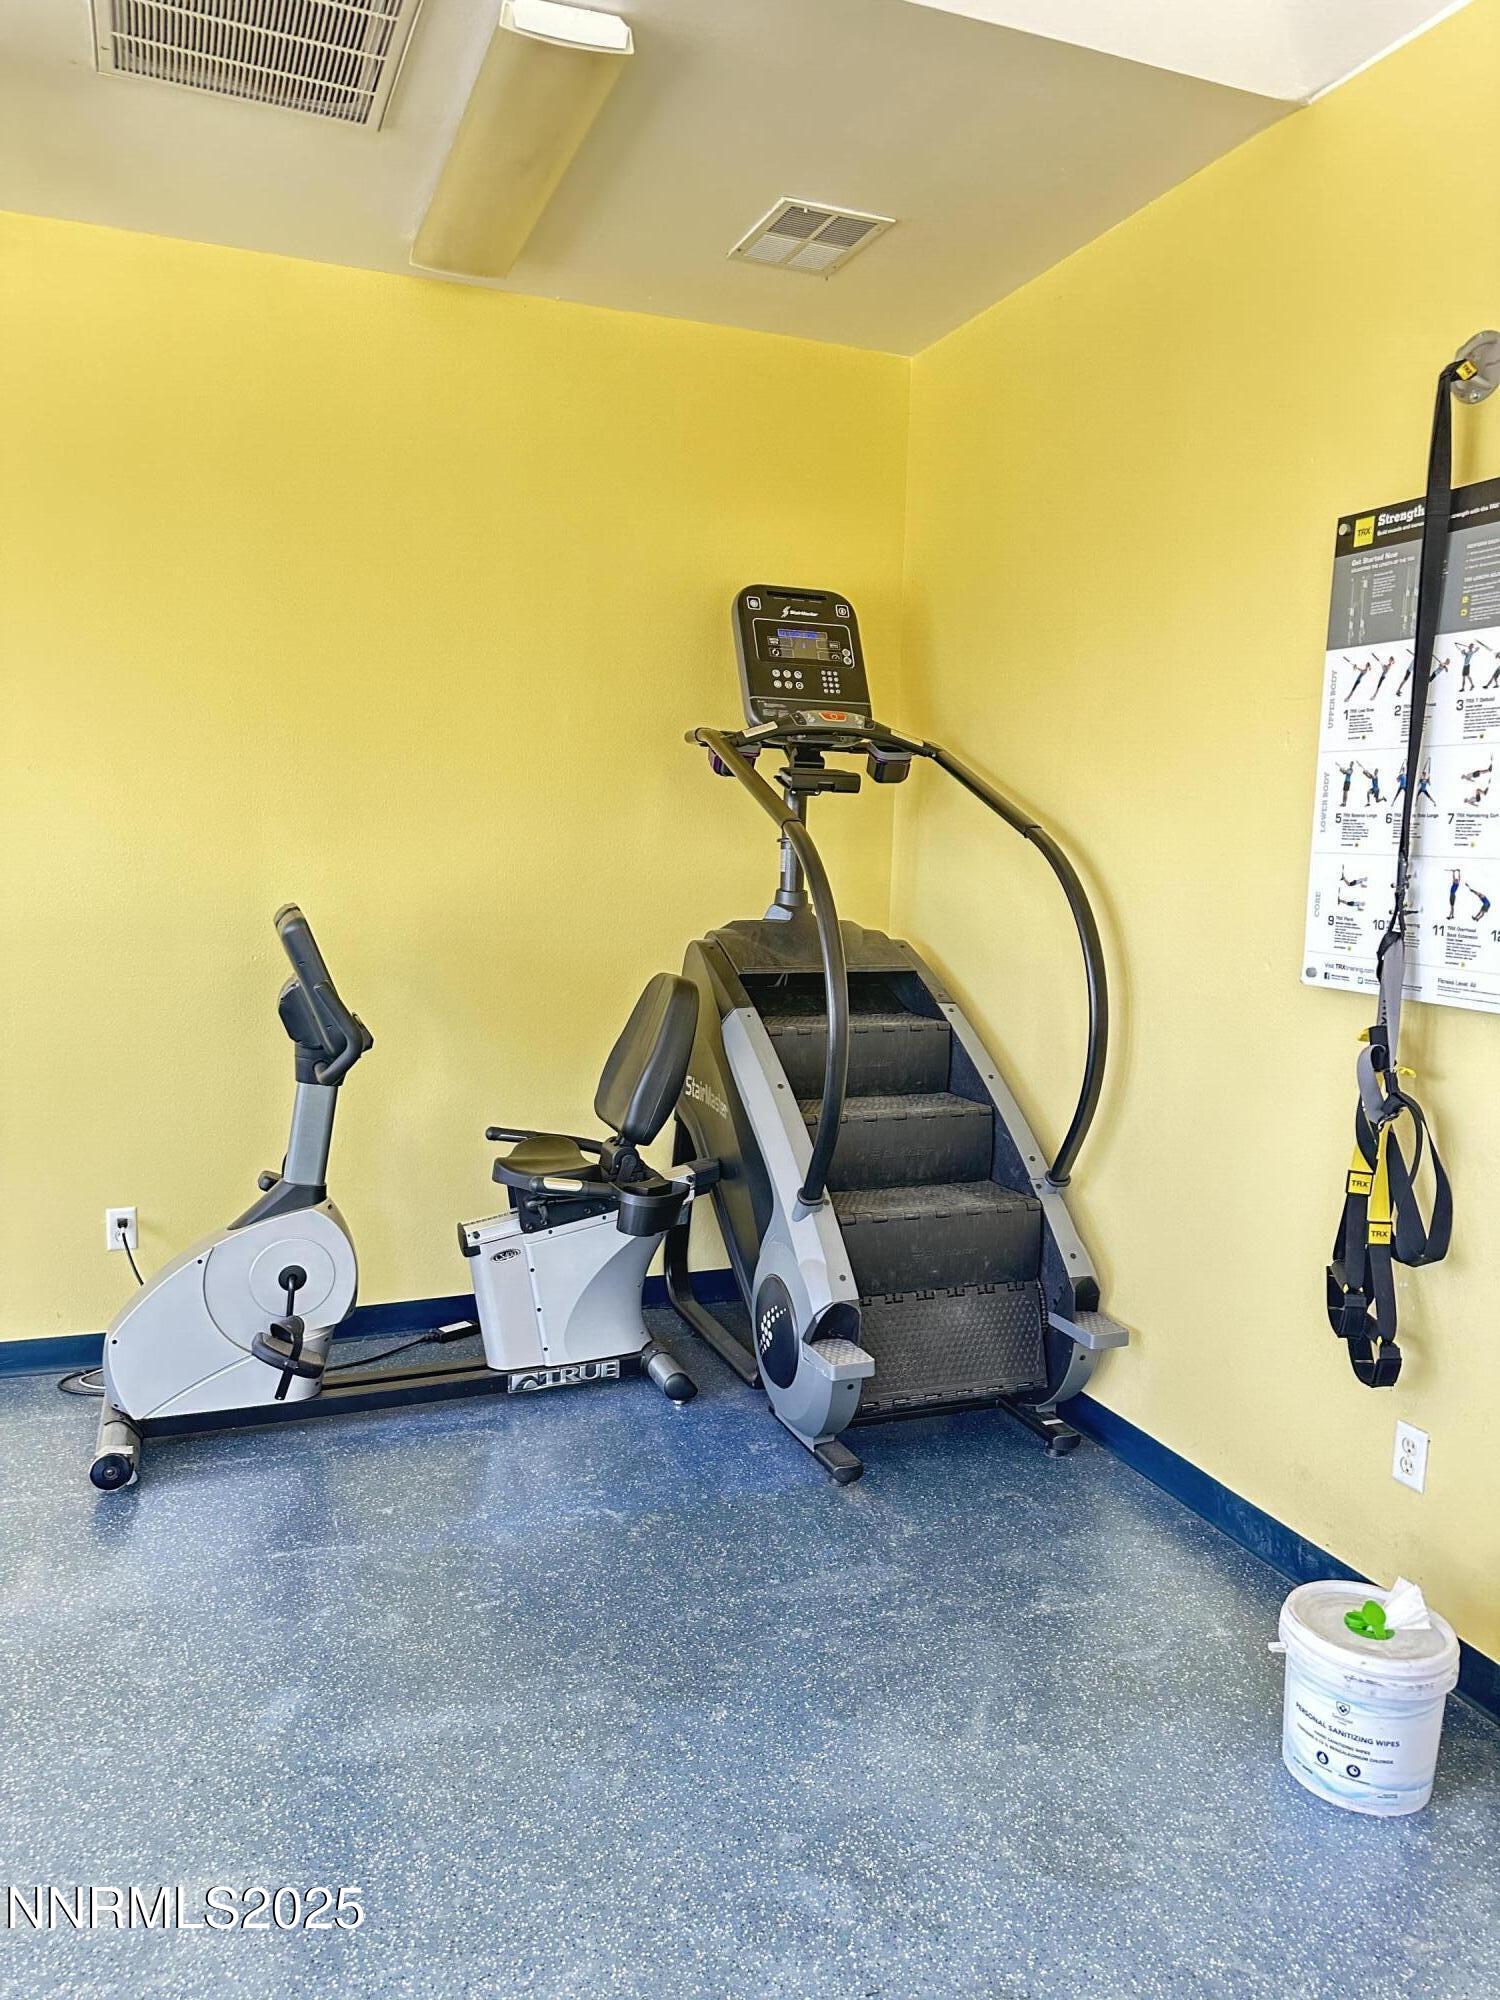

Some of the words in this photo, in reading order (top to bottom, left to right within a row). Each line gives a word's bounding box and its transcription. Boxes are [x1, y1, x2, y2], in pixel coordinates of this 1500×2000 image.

[1377, 504, 1425, 526] Strength
[1357, 526, 1371, 537] TRX
[1330, 670, 1338, 696] BODY
[1394, 705, 1401, 716] 2
[1456, 699, 1464, 711] 3
[1343, 709, 1349, 720] 1
[1322, 772, 1330, 798] BODY
[1335, 813, 1341, 823] 5
[1385, 813, 1392, 824] 6
[1447, 813, 1454, 824] 7
[1327, 915, 1334, 926] 9
[1372, 919, 1385, 930] 10
[1432, 924, 1444, 937] 11
[1371, 1230, 1388, 1238] TRX
[540, 1361, 618, 1385] TRUE
[1296, 1701, 1326, 1729] PERSONAL
[1327, 1725, 1374, 1745] SANITIZING
[1376, 1739, 1400, 1747] WIPES
